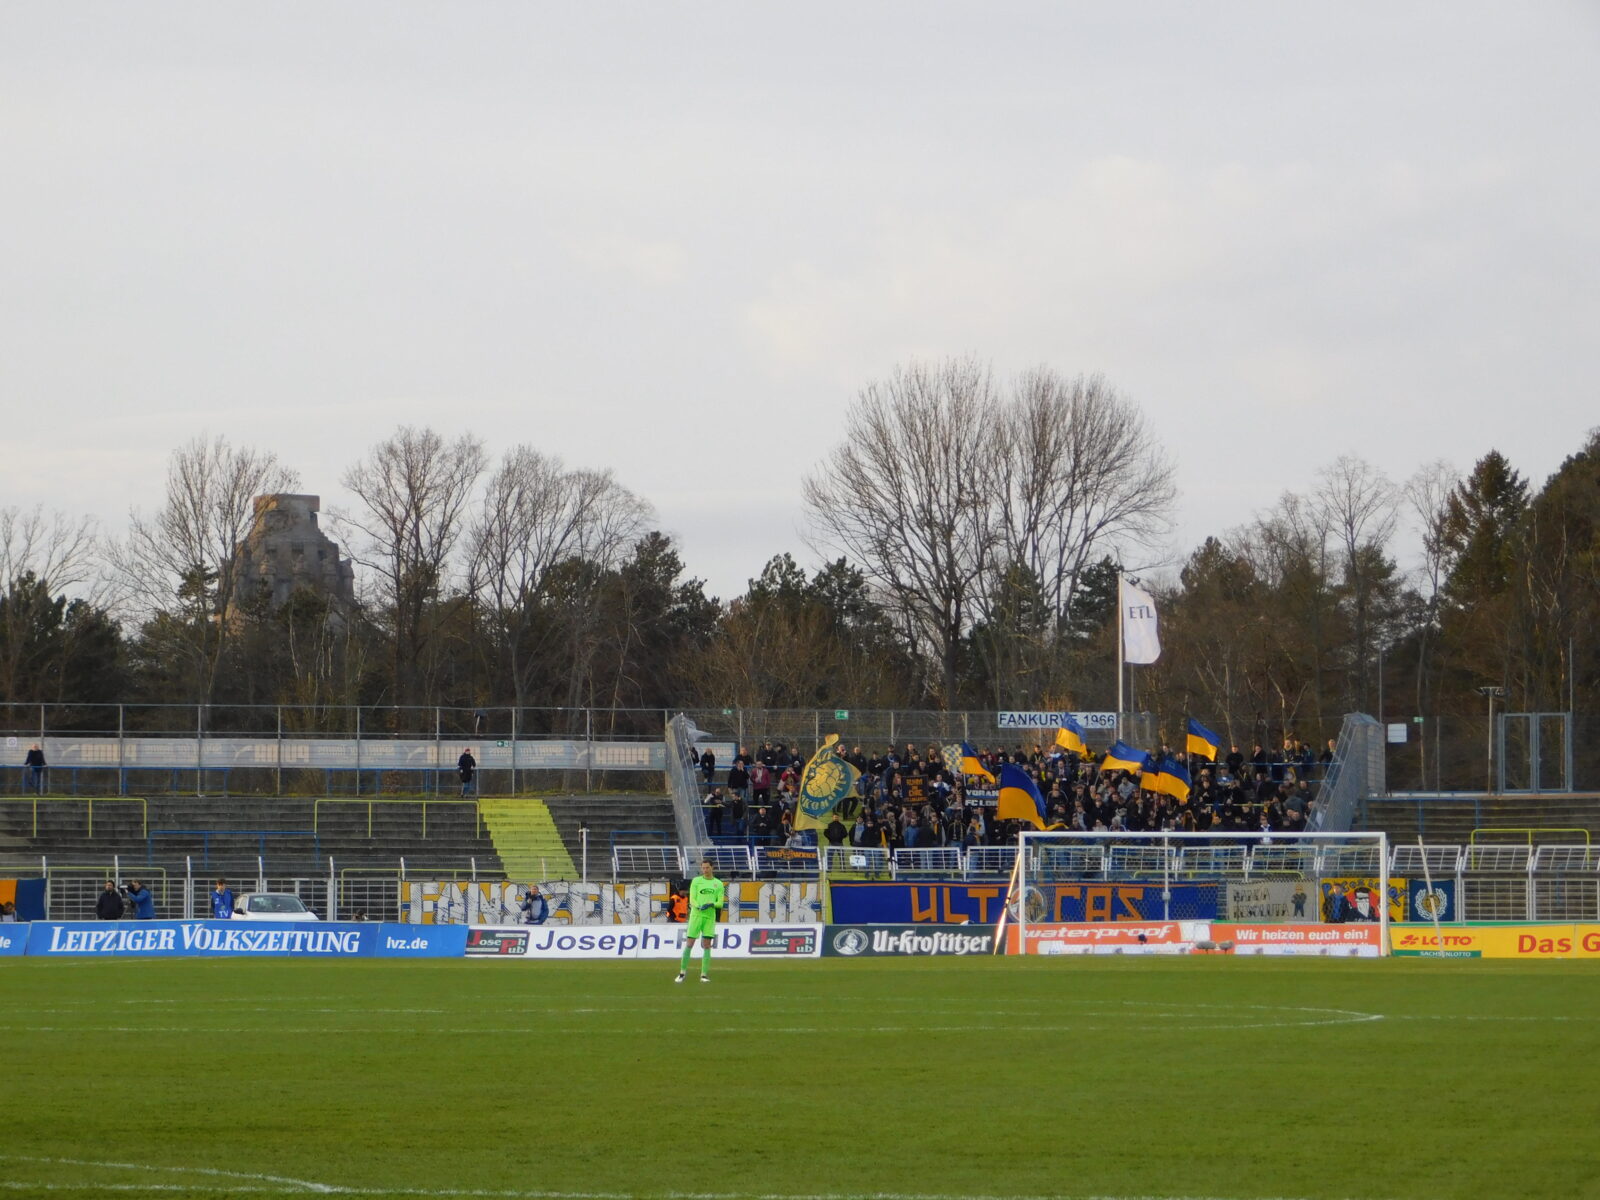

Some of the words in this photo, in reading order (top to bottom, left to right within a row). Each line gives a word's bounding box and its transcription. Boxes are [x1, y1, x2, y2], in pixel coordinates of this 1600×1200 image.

[1129, 605, 1153, 619] ETL
[1083, 714, 1115, 727] 1966
[48, 926, 177, 952] LEIPZIGER
[180, 923, 360, 953] VOLKSZEITUNG
[1024, 924, 1175, 939] waterproof
[1236, 929, 1258, 940] Wir
[1262, 929, 1304, 940] heizen
[1308, 929, 1340, 940] euch
[1343, 929, 1369, 940] ein!
[386, 936, 428, 949] lvz.de
[1422, 935, 1473, 946] LOTTO
[1518, 934, 1572, 953] Das
